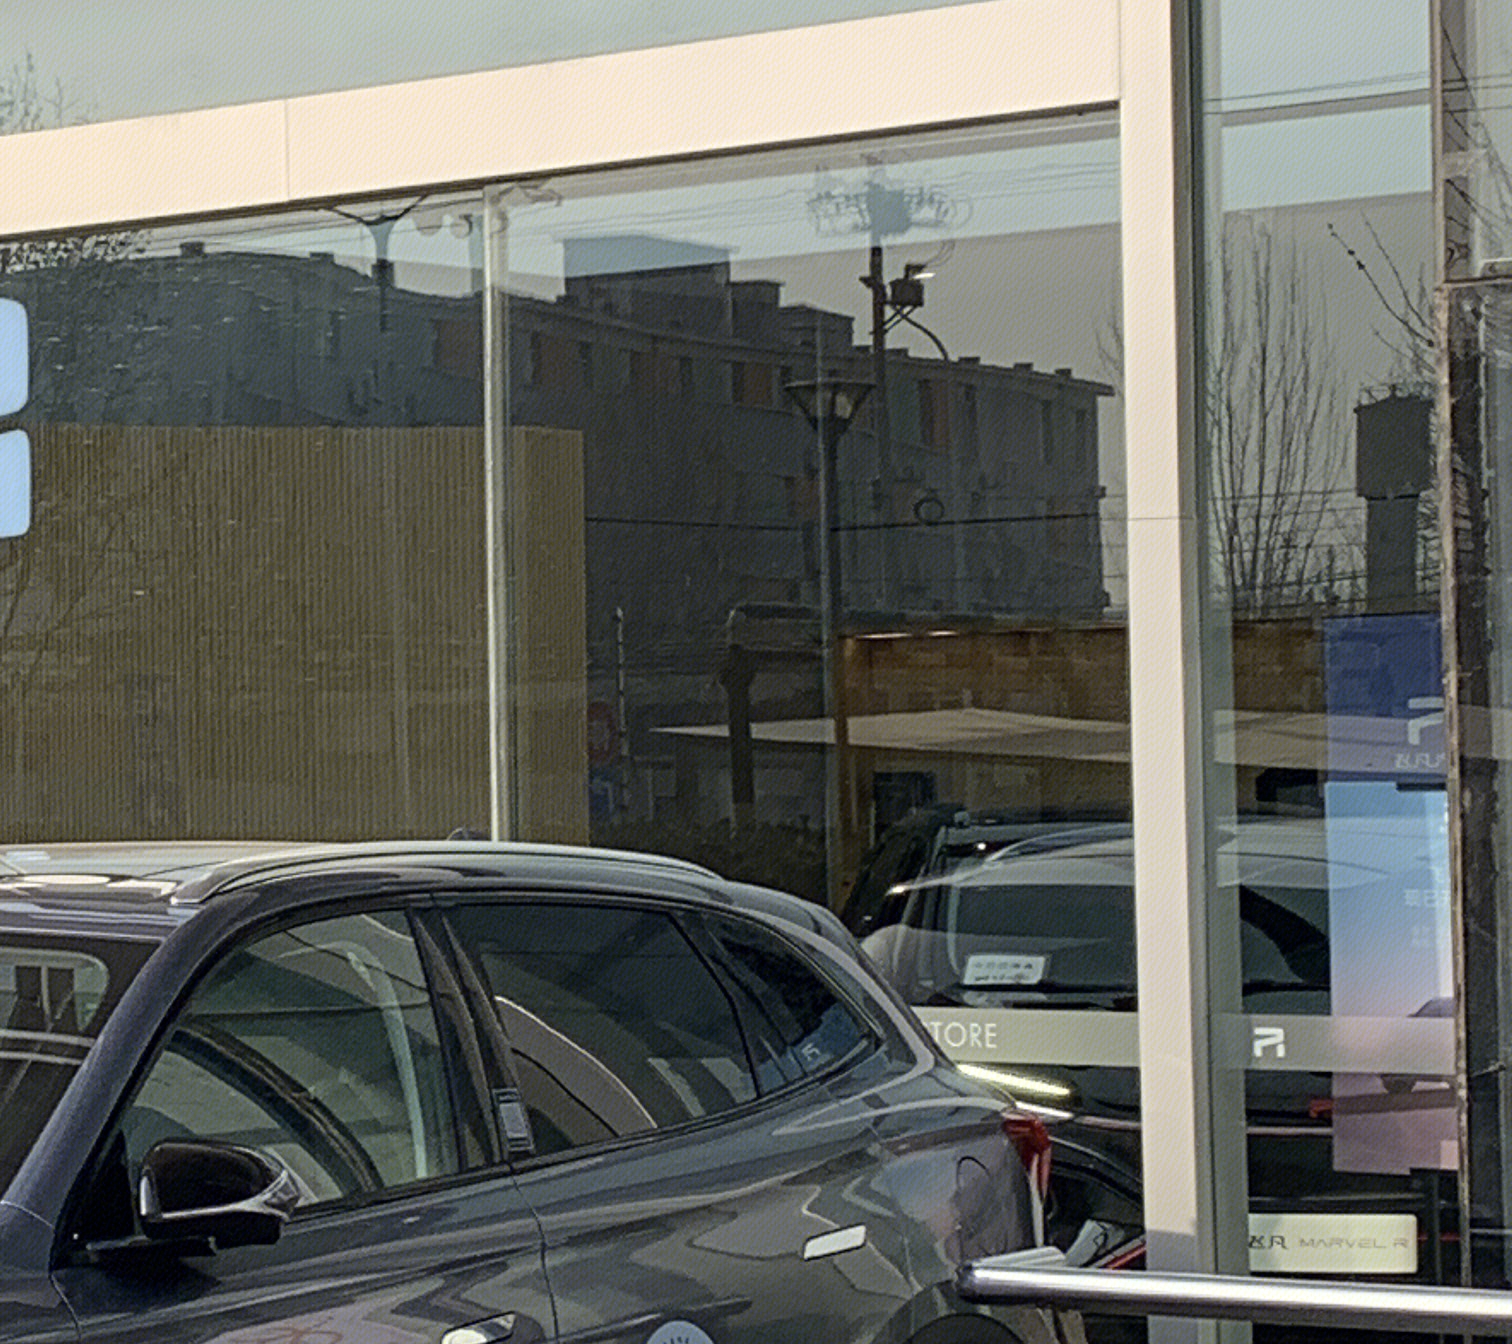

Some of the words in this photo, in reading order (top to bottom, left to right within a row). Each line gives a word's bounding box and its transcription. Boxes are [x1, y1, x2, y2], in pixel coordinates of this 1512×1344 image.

[924, 1020, 998, 1048] TORE
[1300, 1237, 1386, 1249] MARVEL
[1393, 1237, 1409, 1248] R
